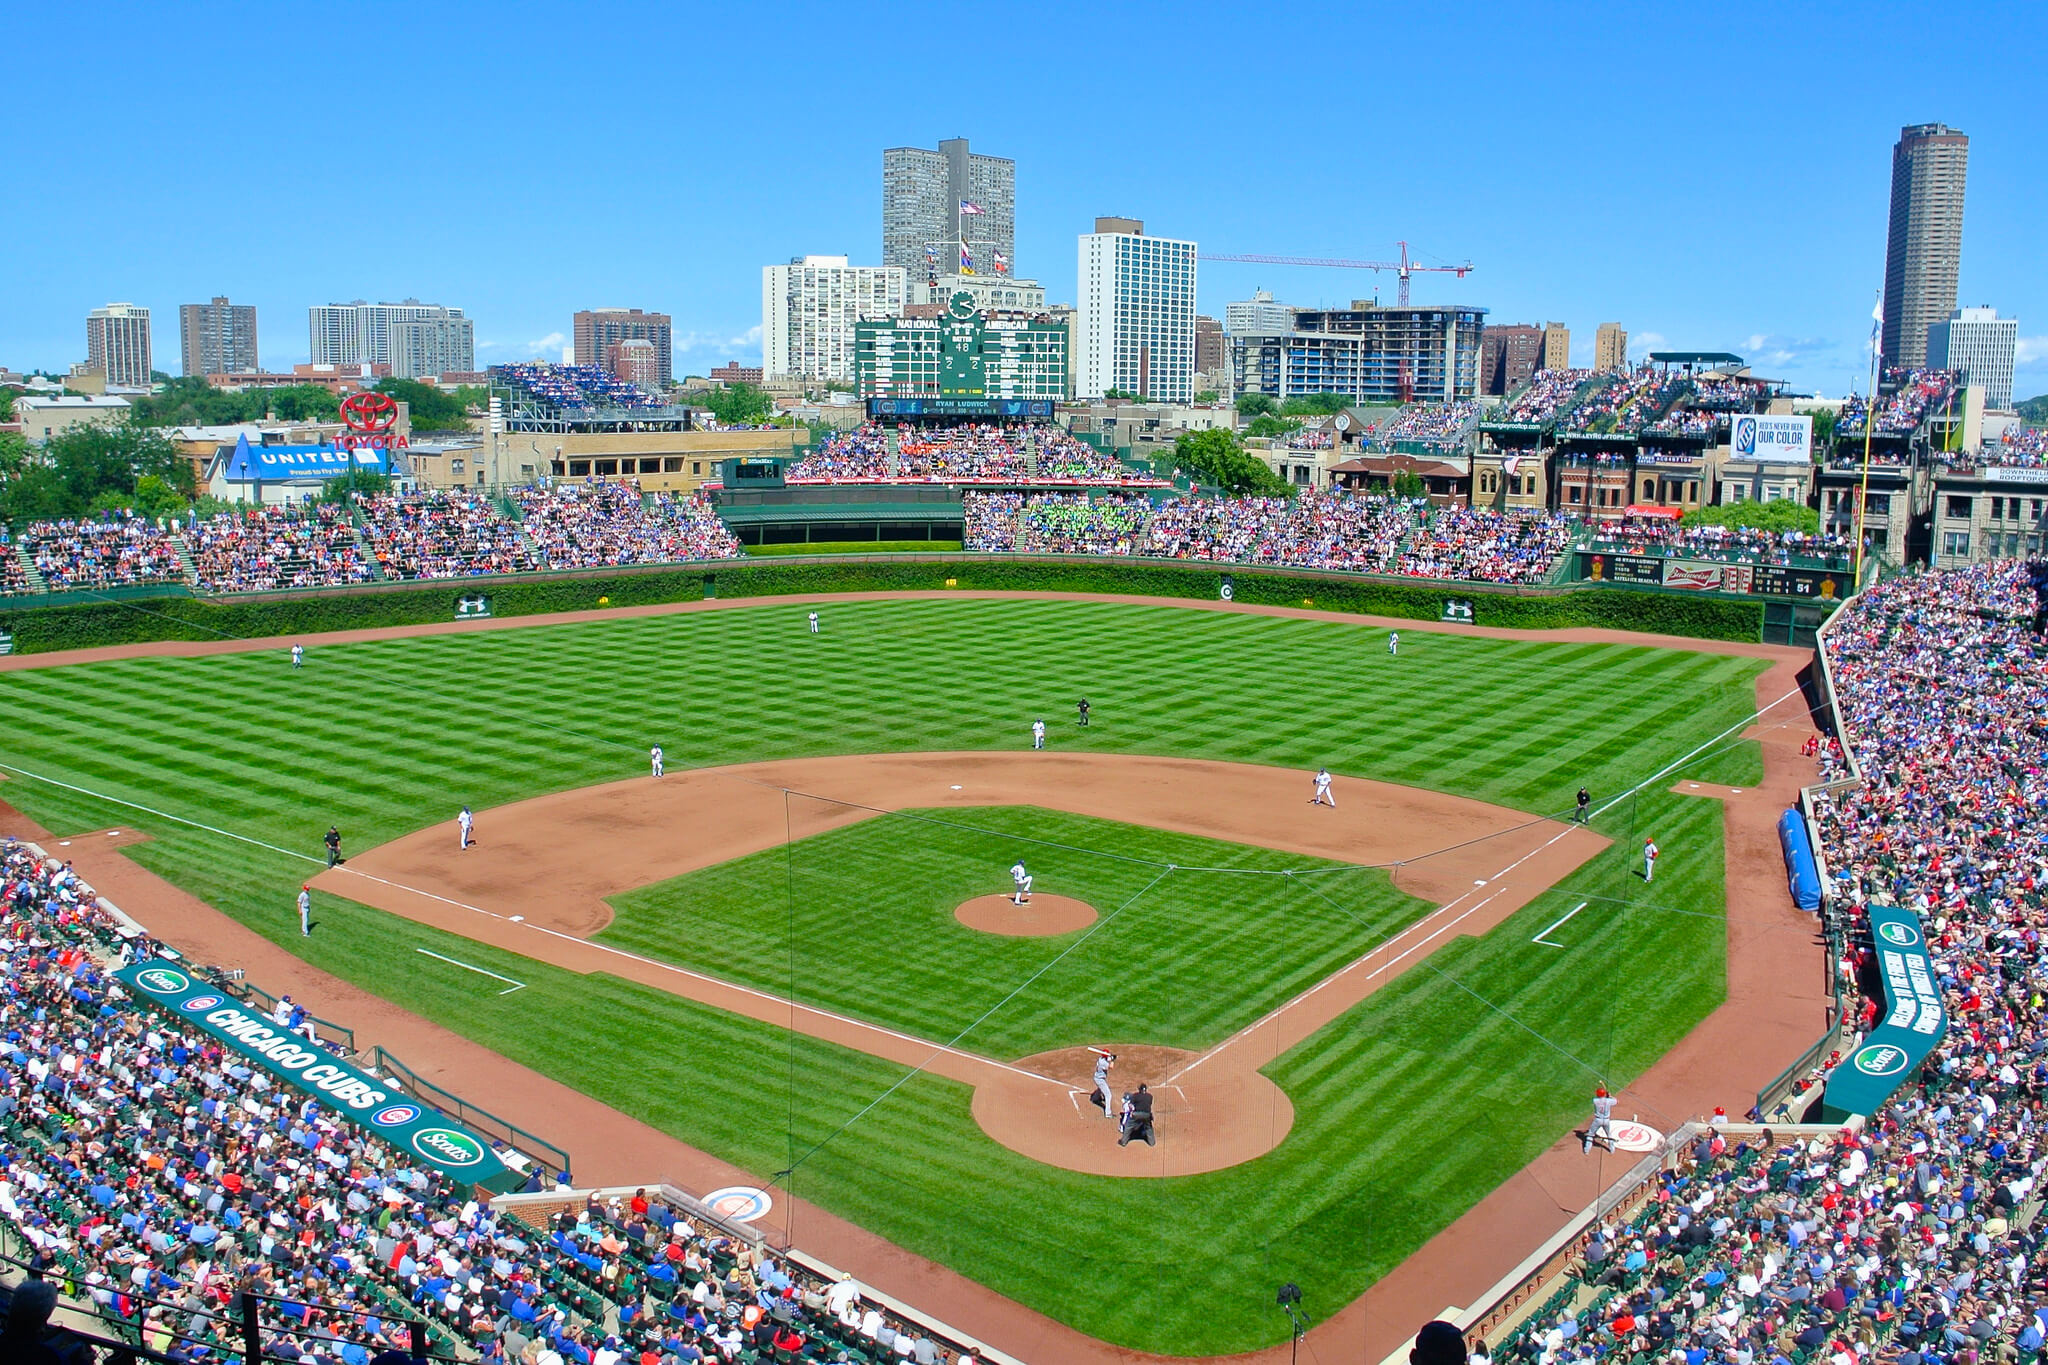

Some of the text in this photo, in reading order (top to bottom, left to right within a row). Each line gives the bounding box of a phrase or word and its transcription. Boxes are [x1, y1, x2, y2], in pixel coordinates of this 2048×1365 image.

[897, 320, 940, 329] NATIONAL
[985, 321, 1028, 330] AMERICAN
[955, 343, 969, 352] 48
[946, 360, 952, 369] 2
[972, 360, 978, 369] 2
[1774, 422, 1790, 430] NEVER
[1791, 423, 1804, 431] BEEN
[332, 435, 409, 450] TOYOTA
[1758, 430, 1803, 444] OUR COLOR
[261, 452, 349, 464] UNITED
[1625, 508, 1673, 518] Budweiser
[1671, 567, 1710, 580] Budweiser
[1796, 583, 1810, 593] 51
[145, 969, 180, 991] Scotts
[206, 1008, 386, 1109] CHICAGO CUBS
[1863, 1048, 1898, 1072] Scotts
[422, 1133, 472, 1161] Scotts
